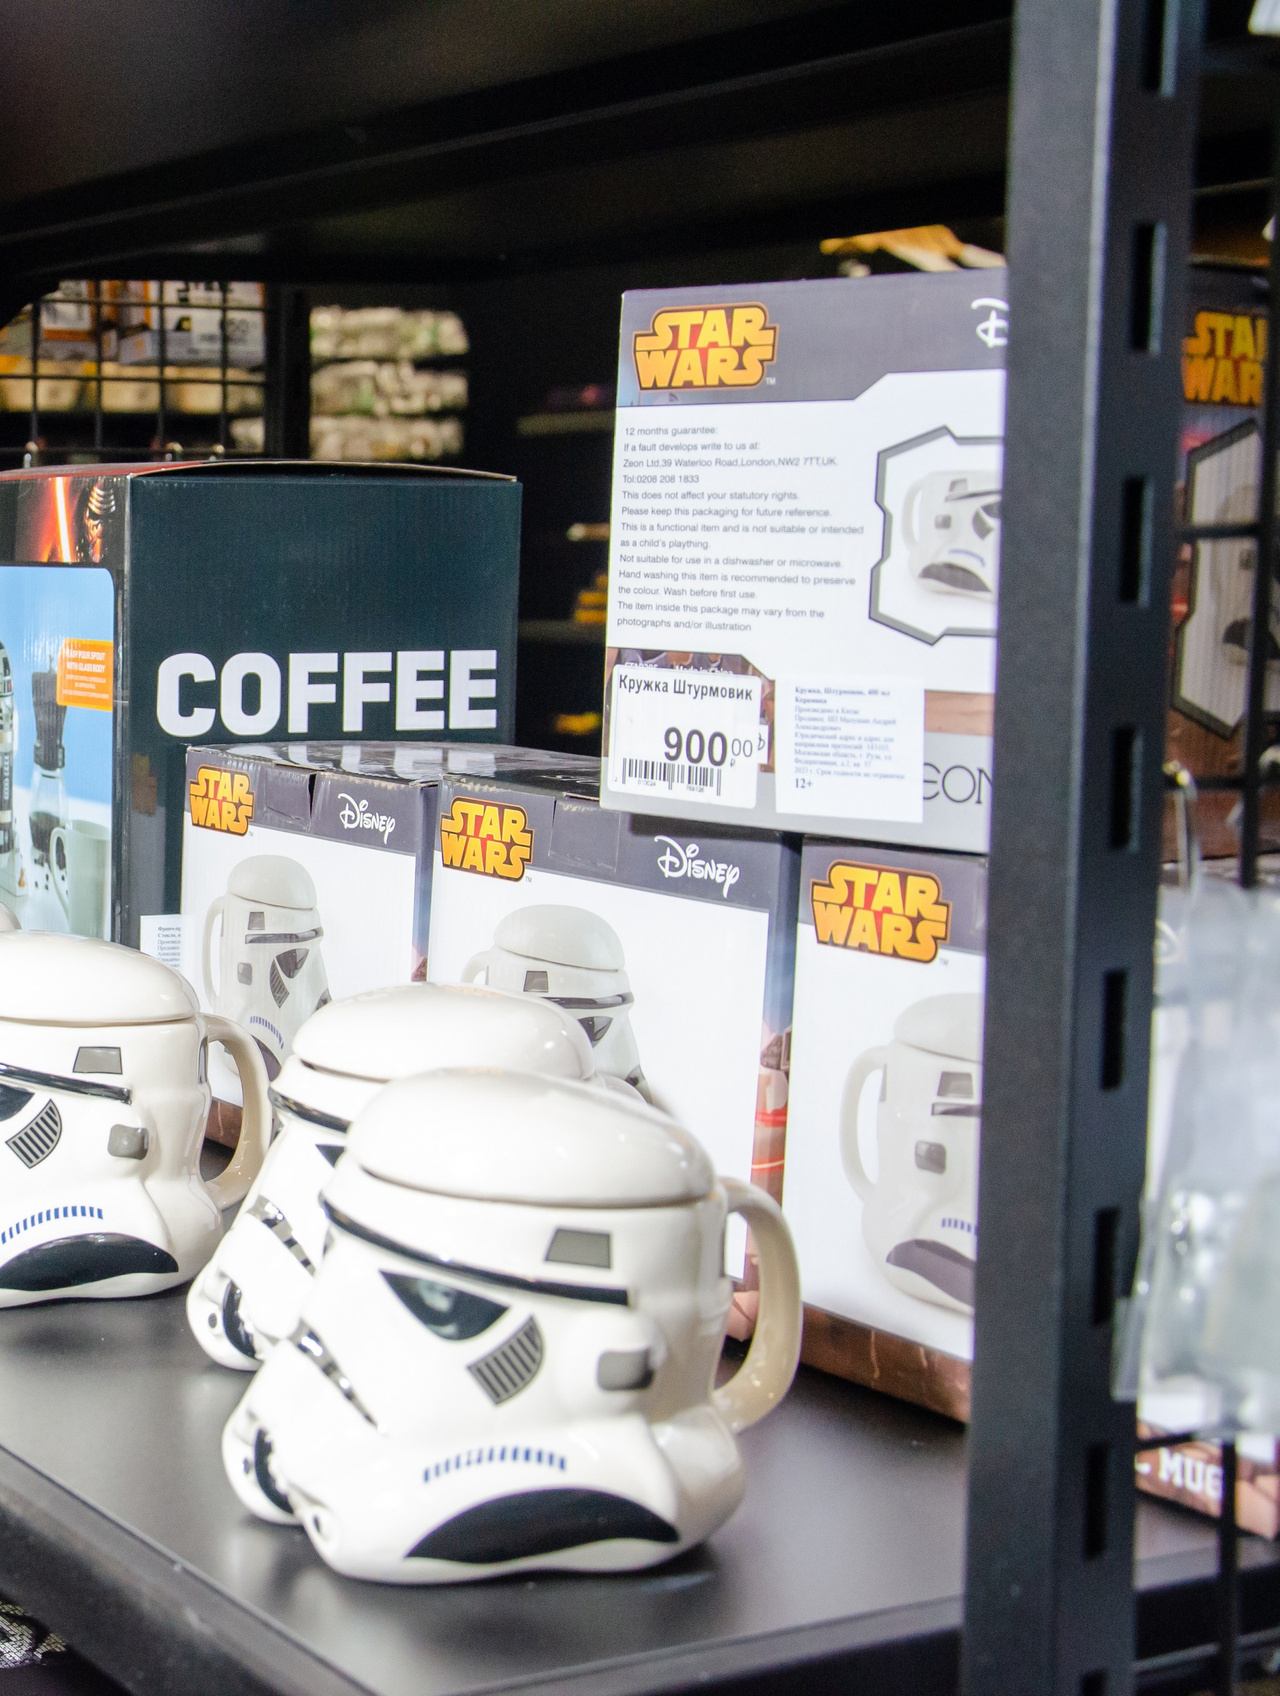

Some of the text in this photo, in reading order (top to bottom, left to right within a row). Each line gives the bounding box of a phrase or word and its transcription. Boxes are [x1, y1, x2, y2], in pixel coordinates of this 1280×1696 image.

[635, 307, 774, 350] STAR
[636, 345, 773, 388] WARS
[624, 444, 629, 452] If
[659, 443, 697, 452] develops
[624, 459, 643, 467] Zeon
[675, 459, 712, 467] Waterloo
[660, 475, 675, 483] 208
[679, 475, 699, 483] 1833
[623, 491, 639, 499] This
[642, 491, 661, 499] does
[681, 491, 704, 499] affect
[707, 493, 726, 501] your
[730, 492, 768, 501] statutory
[622, 507, 648, 515] Please
[651, 507, 671, 516] keep
[675, 507, 689, 515] this
[692, 508, 738, 517] packaging
[742, 508, 753, 516] for
[757, 508, 782, 516] future
[622, 522, 637, 531] This
[641, 523, 646, 531] is
[657, 523, 698, 531] functional
[702, 524, 719, 532] item
[723, 524, 739, 532] and
[743, 524, 749, 532] is
[770, 525, 805, 533] suitable
[822, 526, 863, 534] intended
[637, 555, 669, 563] suitable
[672, 555, 682, 563] for
[704, 556, 711, 564] in
[723, 557, 774, 565] dishwasher
[619, 570, 855, 586] Hand washing this item is recommended to preserve
[619, 586, 630, 594] the
[664, 587, 687, 596] Wash
[690, 588, 717, 597] before
[721, 589, 736, 598] first
[618, 601, 632, 609] The
[656, 603, 680, 612] inside
[683, 604, 697, 613] this
[701, 606, 738, 615] package
[742, 607, 760, 617] may
[764, 608, 782, 618] vary
[786, 608, 806, 617] from
[810, 610, 824, 618] the
[617, 617, 751, 631] photographs and/or illustration
[156, 650, 497, 737] COFFEE
[619, 674, 753, 700] Кружка Штурмовик
[664, 727, 728, 767] 900
[731, 738, 754, 758] 00
[190, 768, 254, 804] STAR
[795, 778, 813, 788] 12+
[190, 797, 252, 834] WARS
[441, 800, 531, 844] STAR
[441, 832, 529, 877] WARS
[813, 865, 948, 923] STAR
[813, 901, 946, 961] WARS
